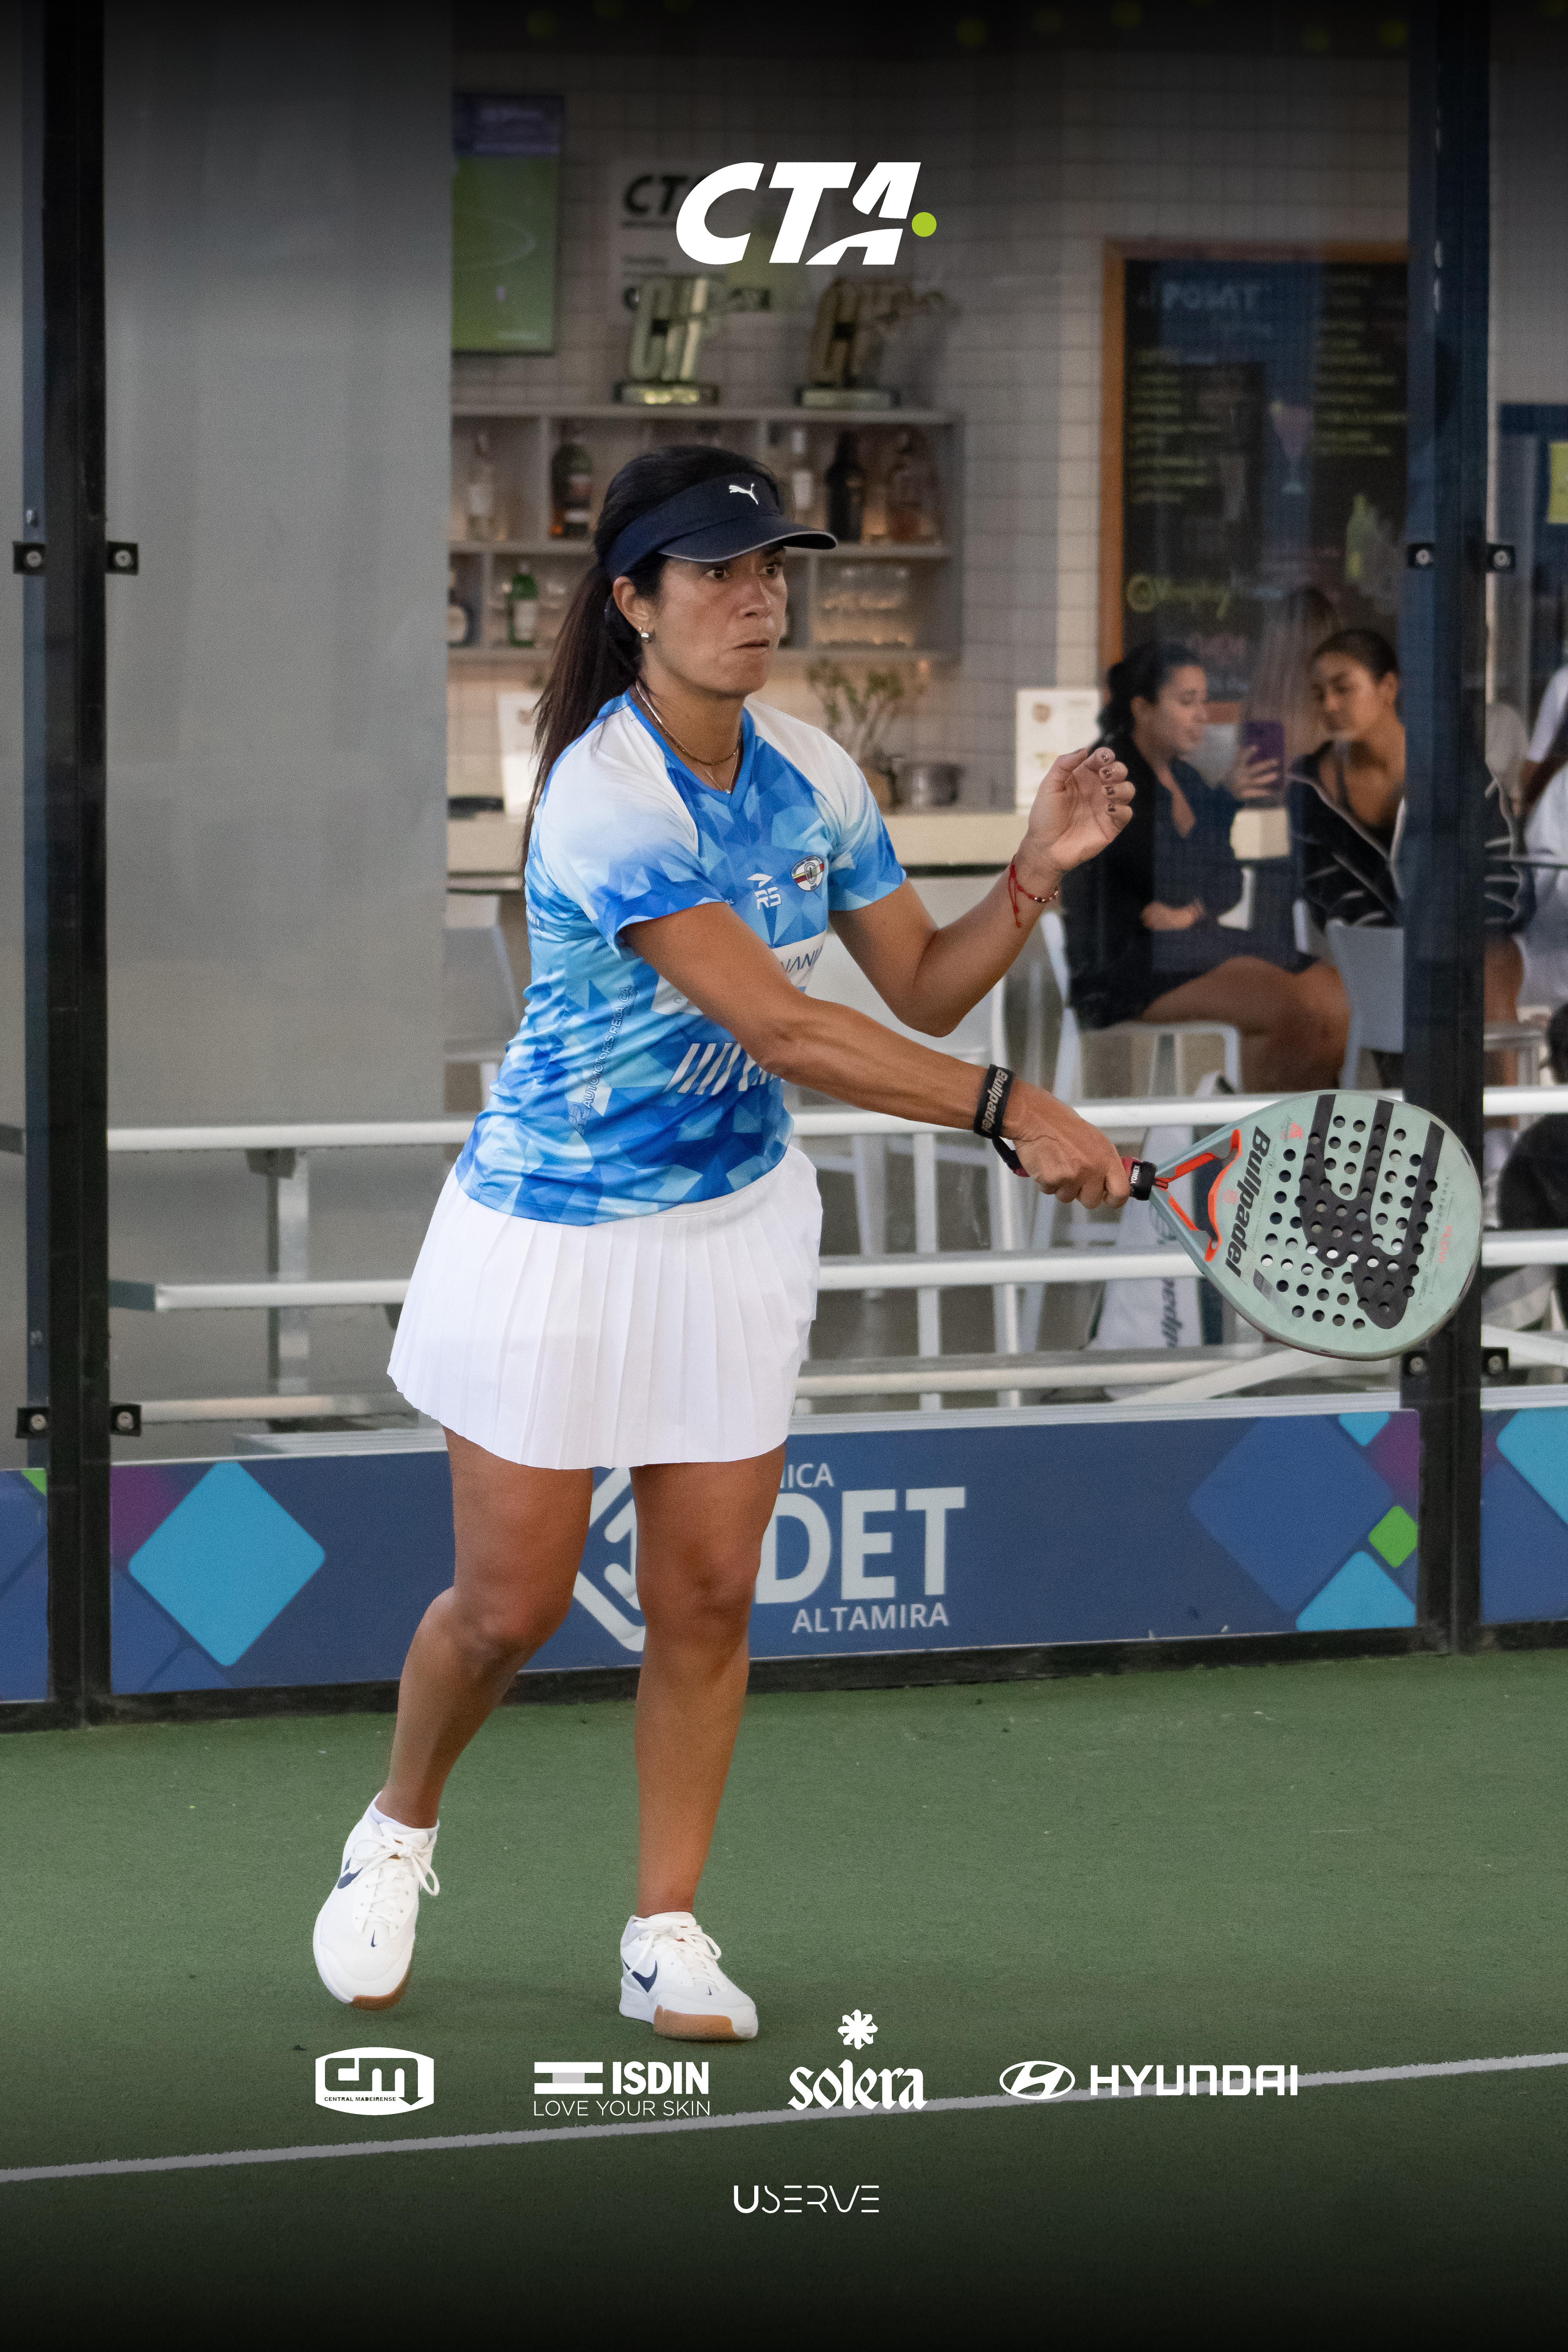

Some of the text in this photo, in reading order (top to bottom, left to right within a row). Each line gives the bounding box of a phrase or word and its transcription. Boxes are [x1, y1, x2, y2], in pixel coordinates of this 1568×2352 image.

[981, 1068, 1009, 1133] Bullpadel
[1130, 1165, 1140, 1184] YONEX
[1225, 1126, 1270, 1278] Bullpadel
[1438, 1225, 1452, 1264] FLOW
[792, 1602, 949, 1633] ALTAMIRA
